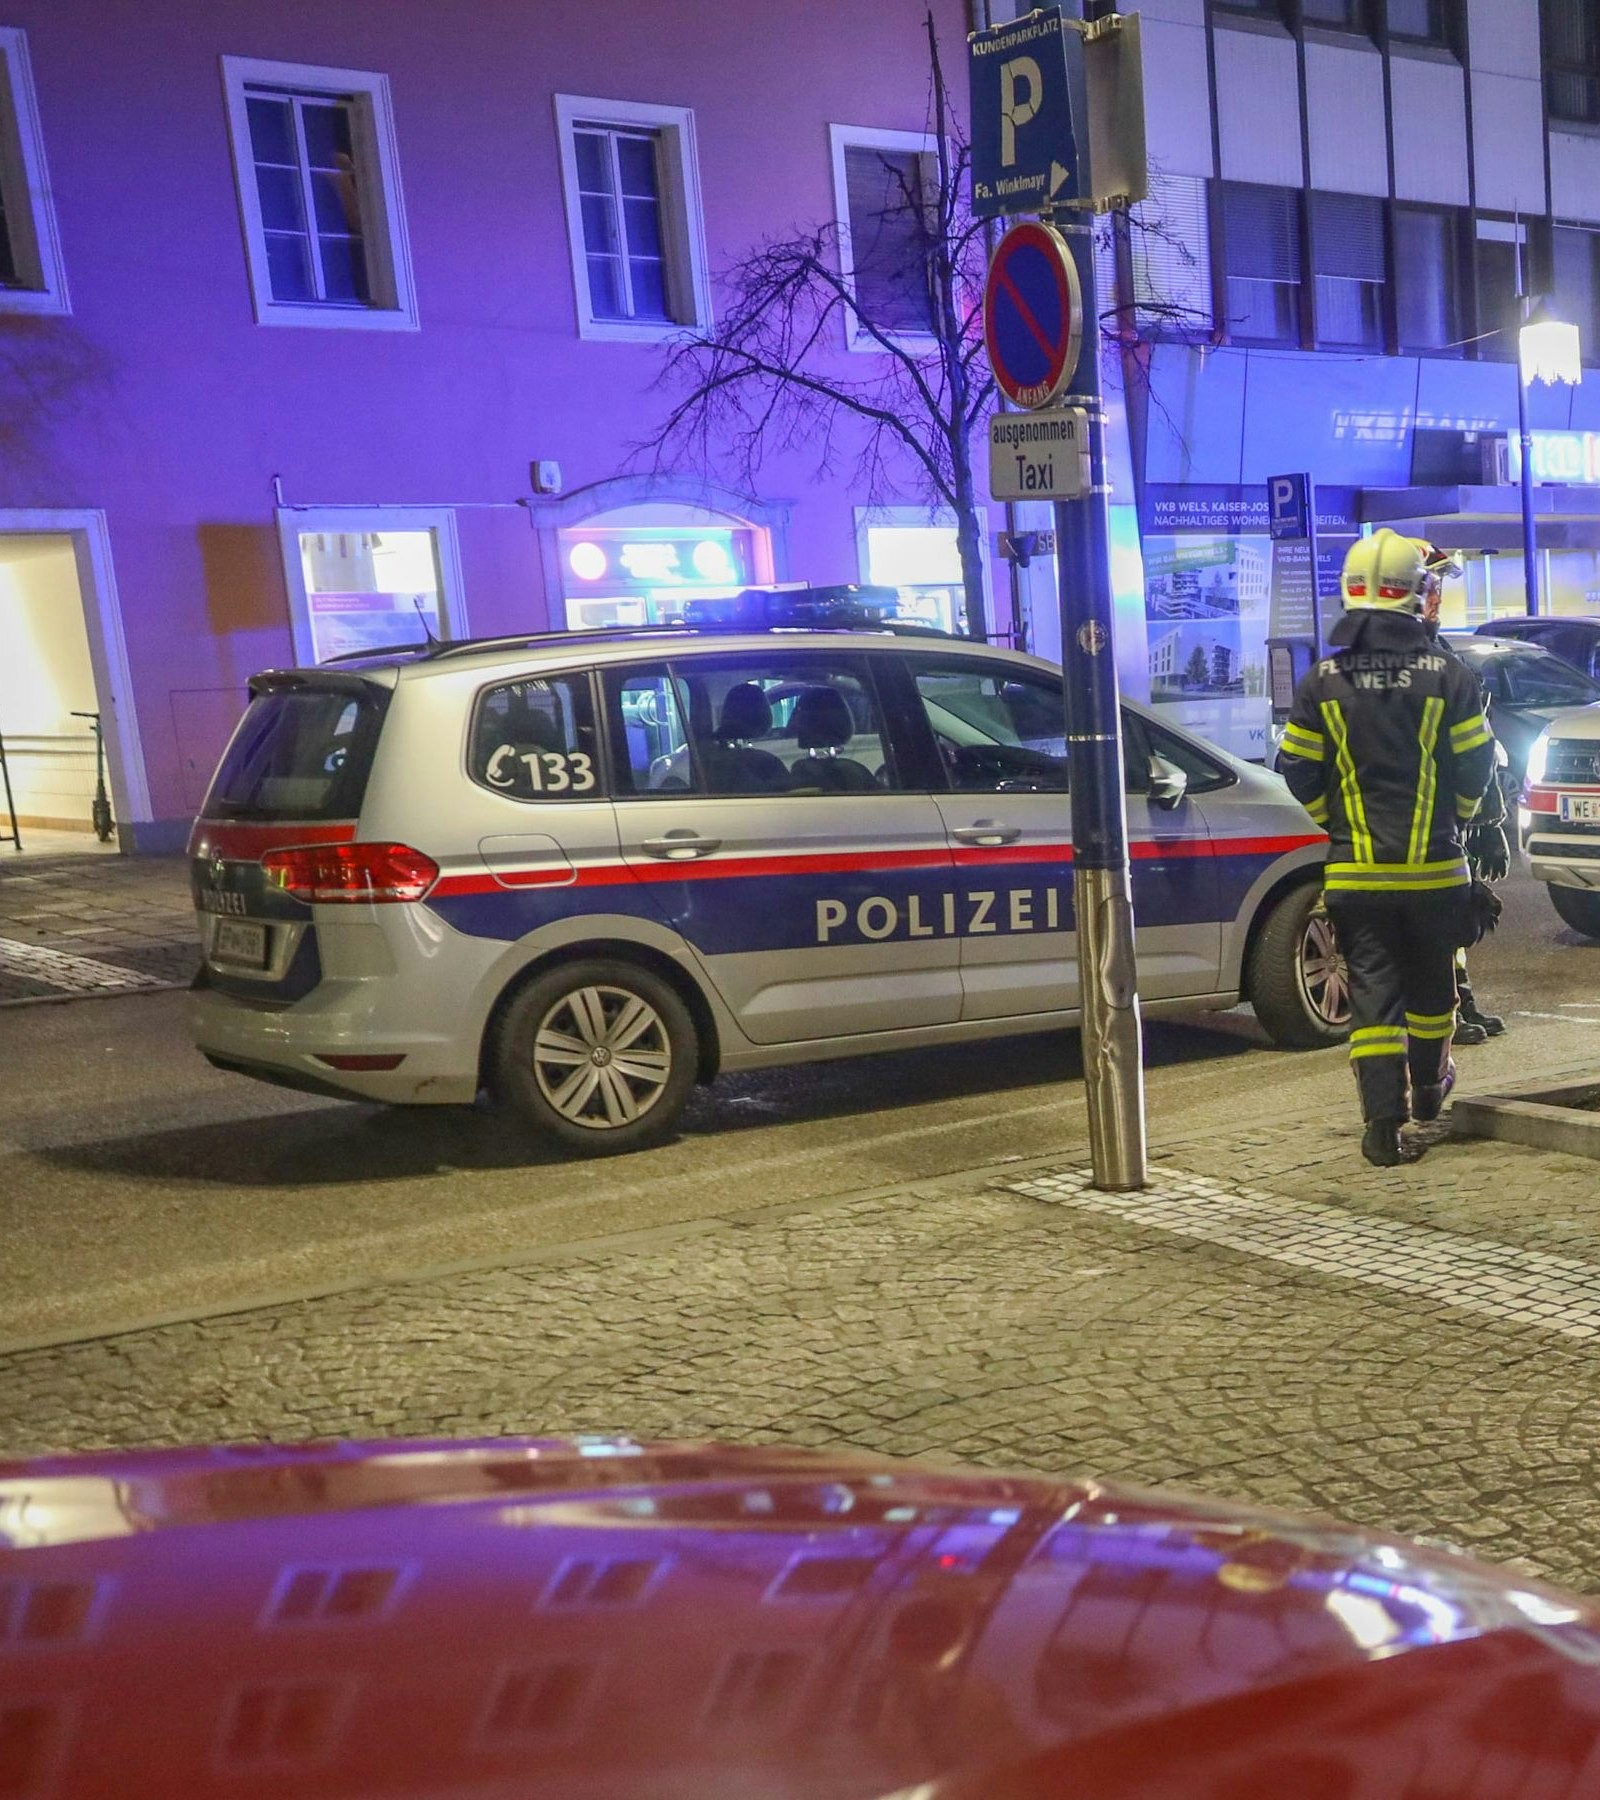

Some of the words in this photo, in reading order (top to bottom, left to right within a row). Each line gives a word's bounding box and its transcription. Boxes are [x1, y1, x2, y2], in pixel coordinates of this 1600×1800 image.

[972, 21, 1060, 57] KUNDENPARKPLATZ
[1000, 56, 1043, 167] P
[975, 182, 993, 199] Fa.
[996, 173, 1046, 196] Winklmayr
[1015, 381, 1050, 405] ANFANG
[993, 420, 1075, 449] ausgenommen
[1015, 454, 1054, 490] Taxi
[1155, 502, 1176, 512] VKB
[1179, 502, 1210, 513] WELS,
[1212, 502, 1269, 512] KAISER-JOS
[1154, 516, 1229, 526] NACHHALTIGES
[1318, 652, 1447, 677] FEUERWEHR
[1352, 670, 1413, 689] WELS
[521, 752, 595, 791] 133
[203, 889, 247, 915] POLIZEI
[816, 888, 1058, 942] POLIZEI
